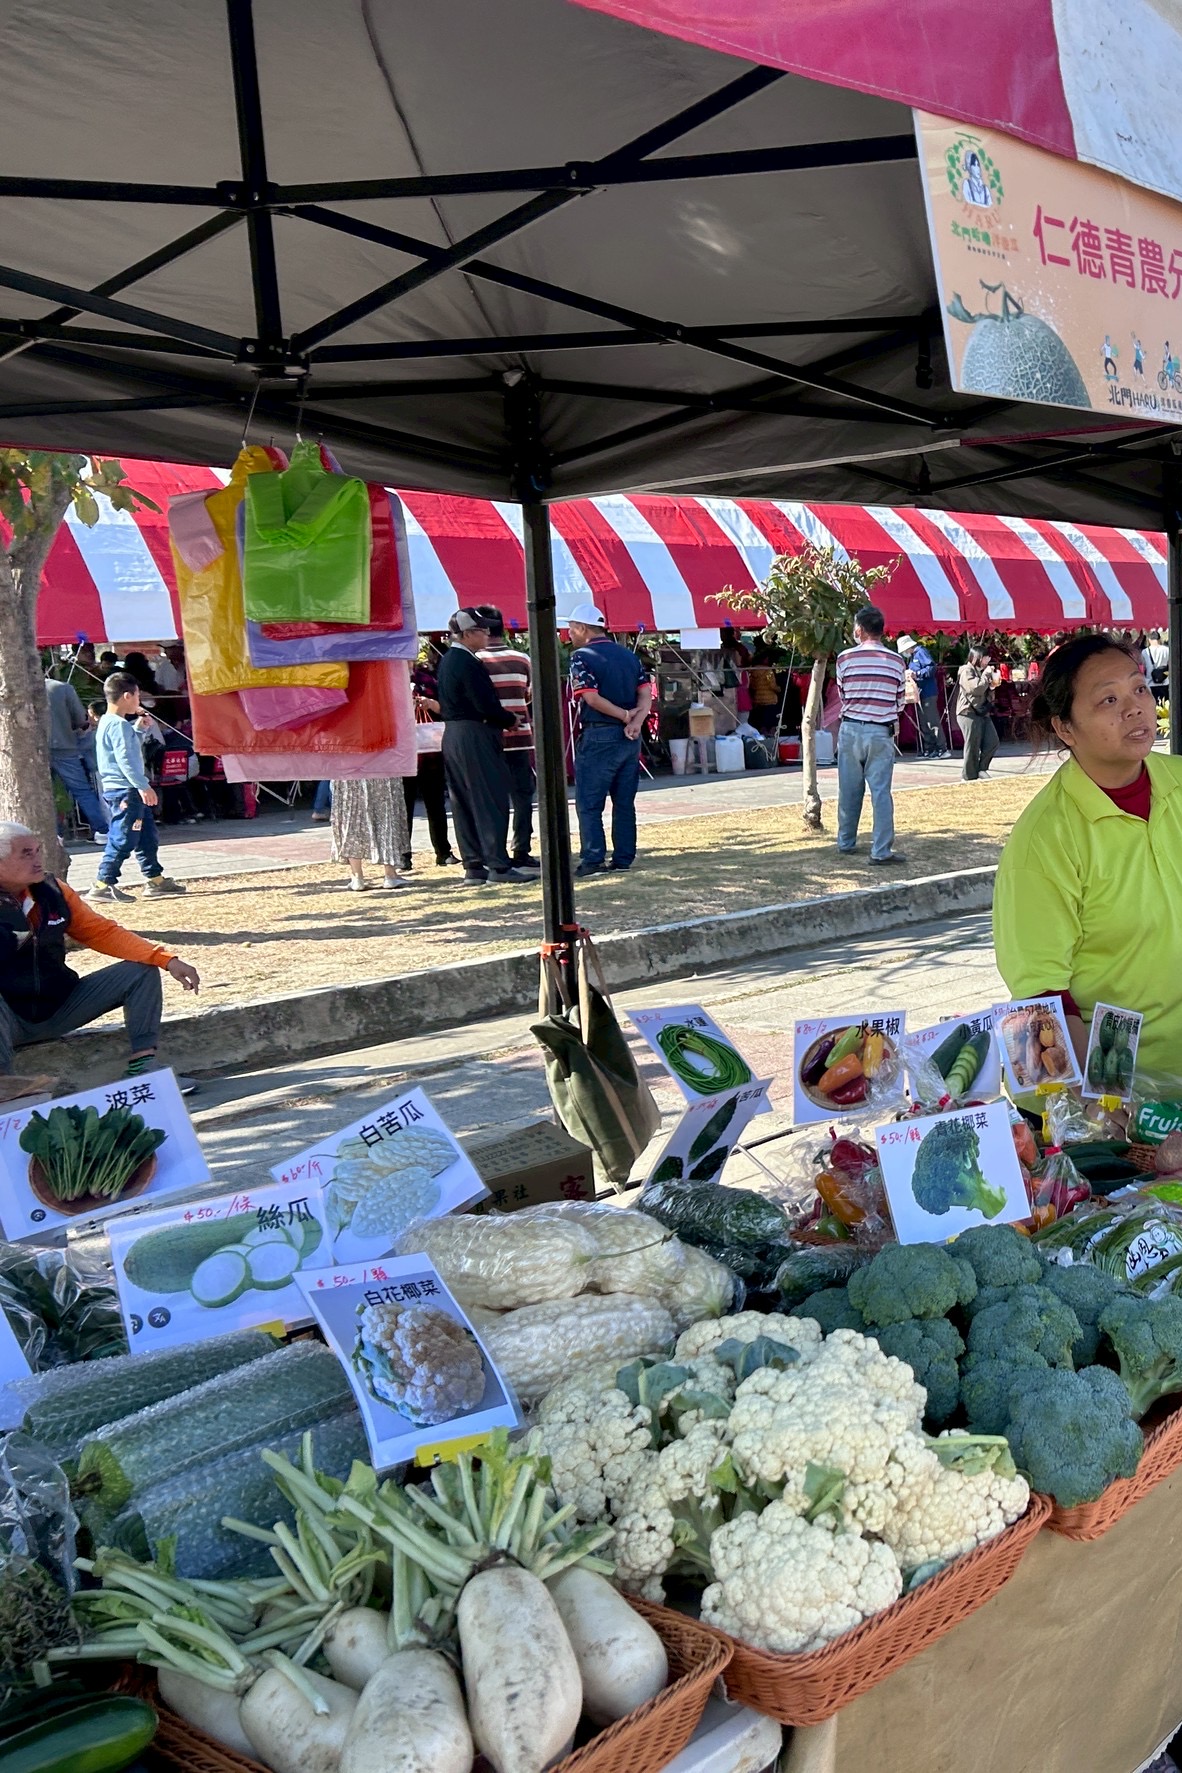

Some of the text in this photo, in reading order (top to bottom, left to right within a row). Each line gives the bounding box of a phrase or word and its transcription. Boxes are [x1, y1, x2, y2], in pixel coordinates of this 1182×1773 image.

[855, 1016, 900, 1039] 水果椒
[958, 1014, 993, 1039] 小黃瓜
[105, 1083, 156, 1111] 波菜
[359, 1100, 425, 1148] 白苦瓜
[934, 1112, 989, 1135] 青花椰菜
[256, 1197, 315, 1233] 絲瓜
[364, 1279, 441, 1306] 白花椰菜
